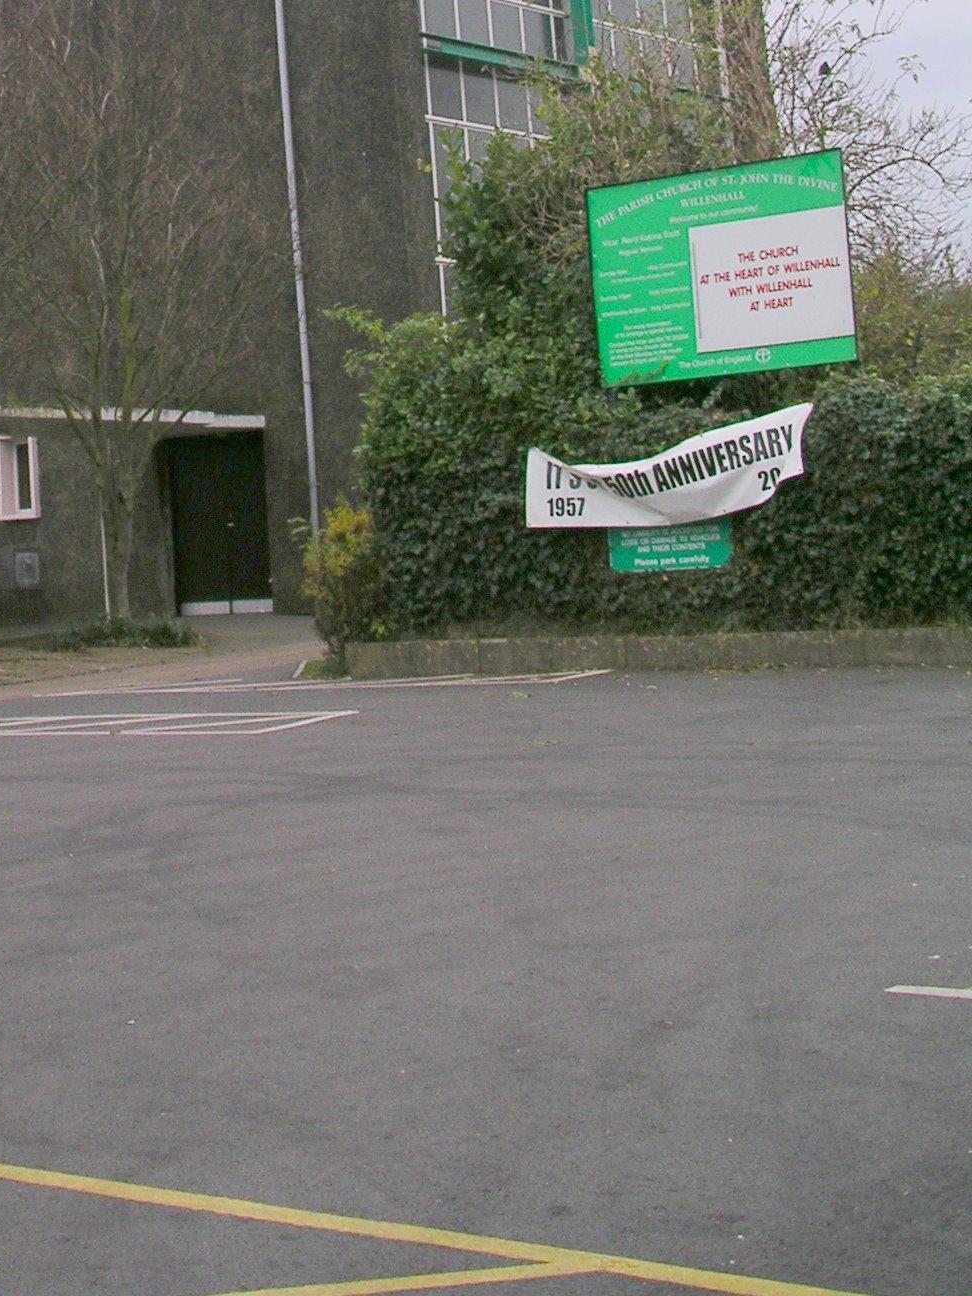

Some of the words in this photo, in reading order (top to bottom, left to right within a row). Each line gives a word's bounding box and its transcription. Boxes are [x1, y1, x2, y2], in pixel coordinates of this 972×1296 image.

[595, 211, 618, 228] THE
[618, 195, 654, 217] PARISH
[657, 180, 702, 201] CHURCH
[704, 175, 719, 188] OF
[740, 173, 768, 185] JOHN
[772, 173, 794, 185] THE
[798, 176, 838, 193] DIVINE
[679, 191, 746, 208] WILLENHALL
[738, 252, 756, 263] THE
[759, 245, 799, 260] CHURCH
[700, 273, 711, 285] AT
[714, 270, 730, 282] THE
[735, 266, 764, 280] HEART
[768, 264, 782, 275] OF
[783, 257, 841, 274] WILLENHALL
[729, 285, 753, 298] WITH
[755, 277, 813, 295] WILLENHALL
[749, 301, 761, 312] AT
[764, 297, 794, 310] HEART
[546, 460, 584, 490] ITS
[652, 424, 794, 491] ANNIVERSARY
[546, 496, 586, 517] 1957
[660, 557, 676, 565] park
[679, 555, 709, 564] carefully
